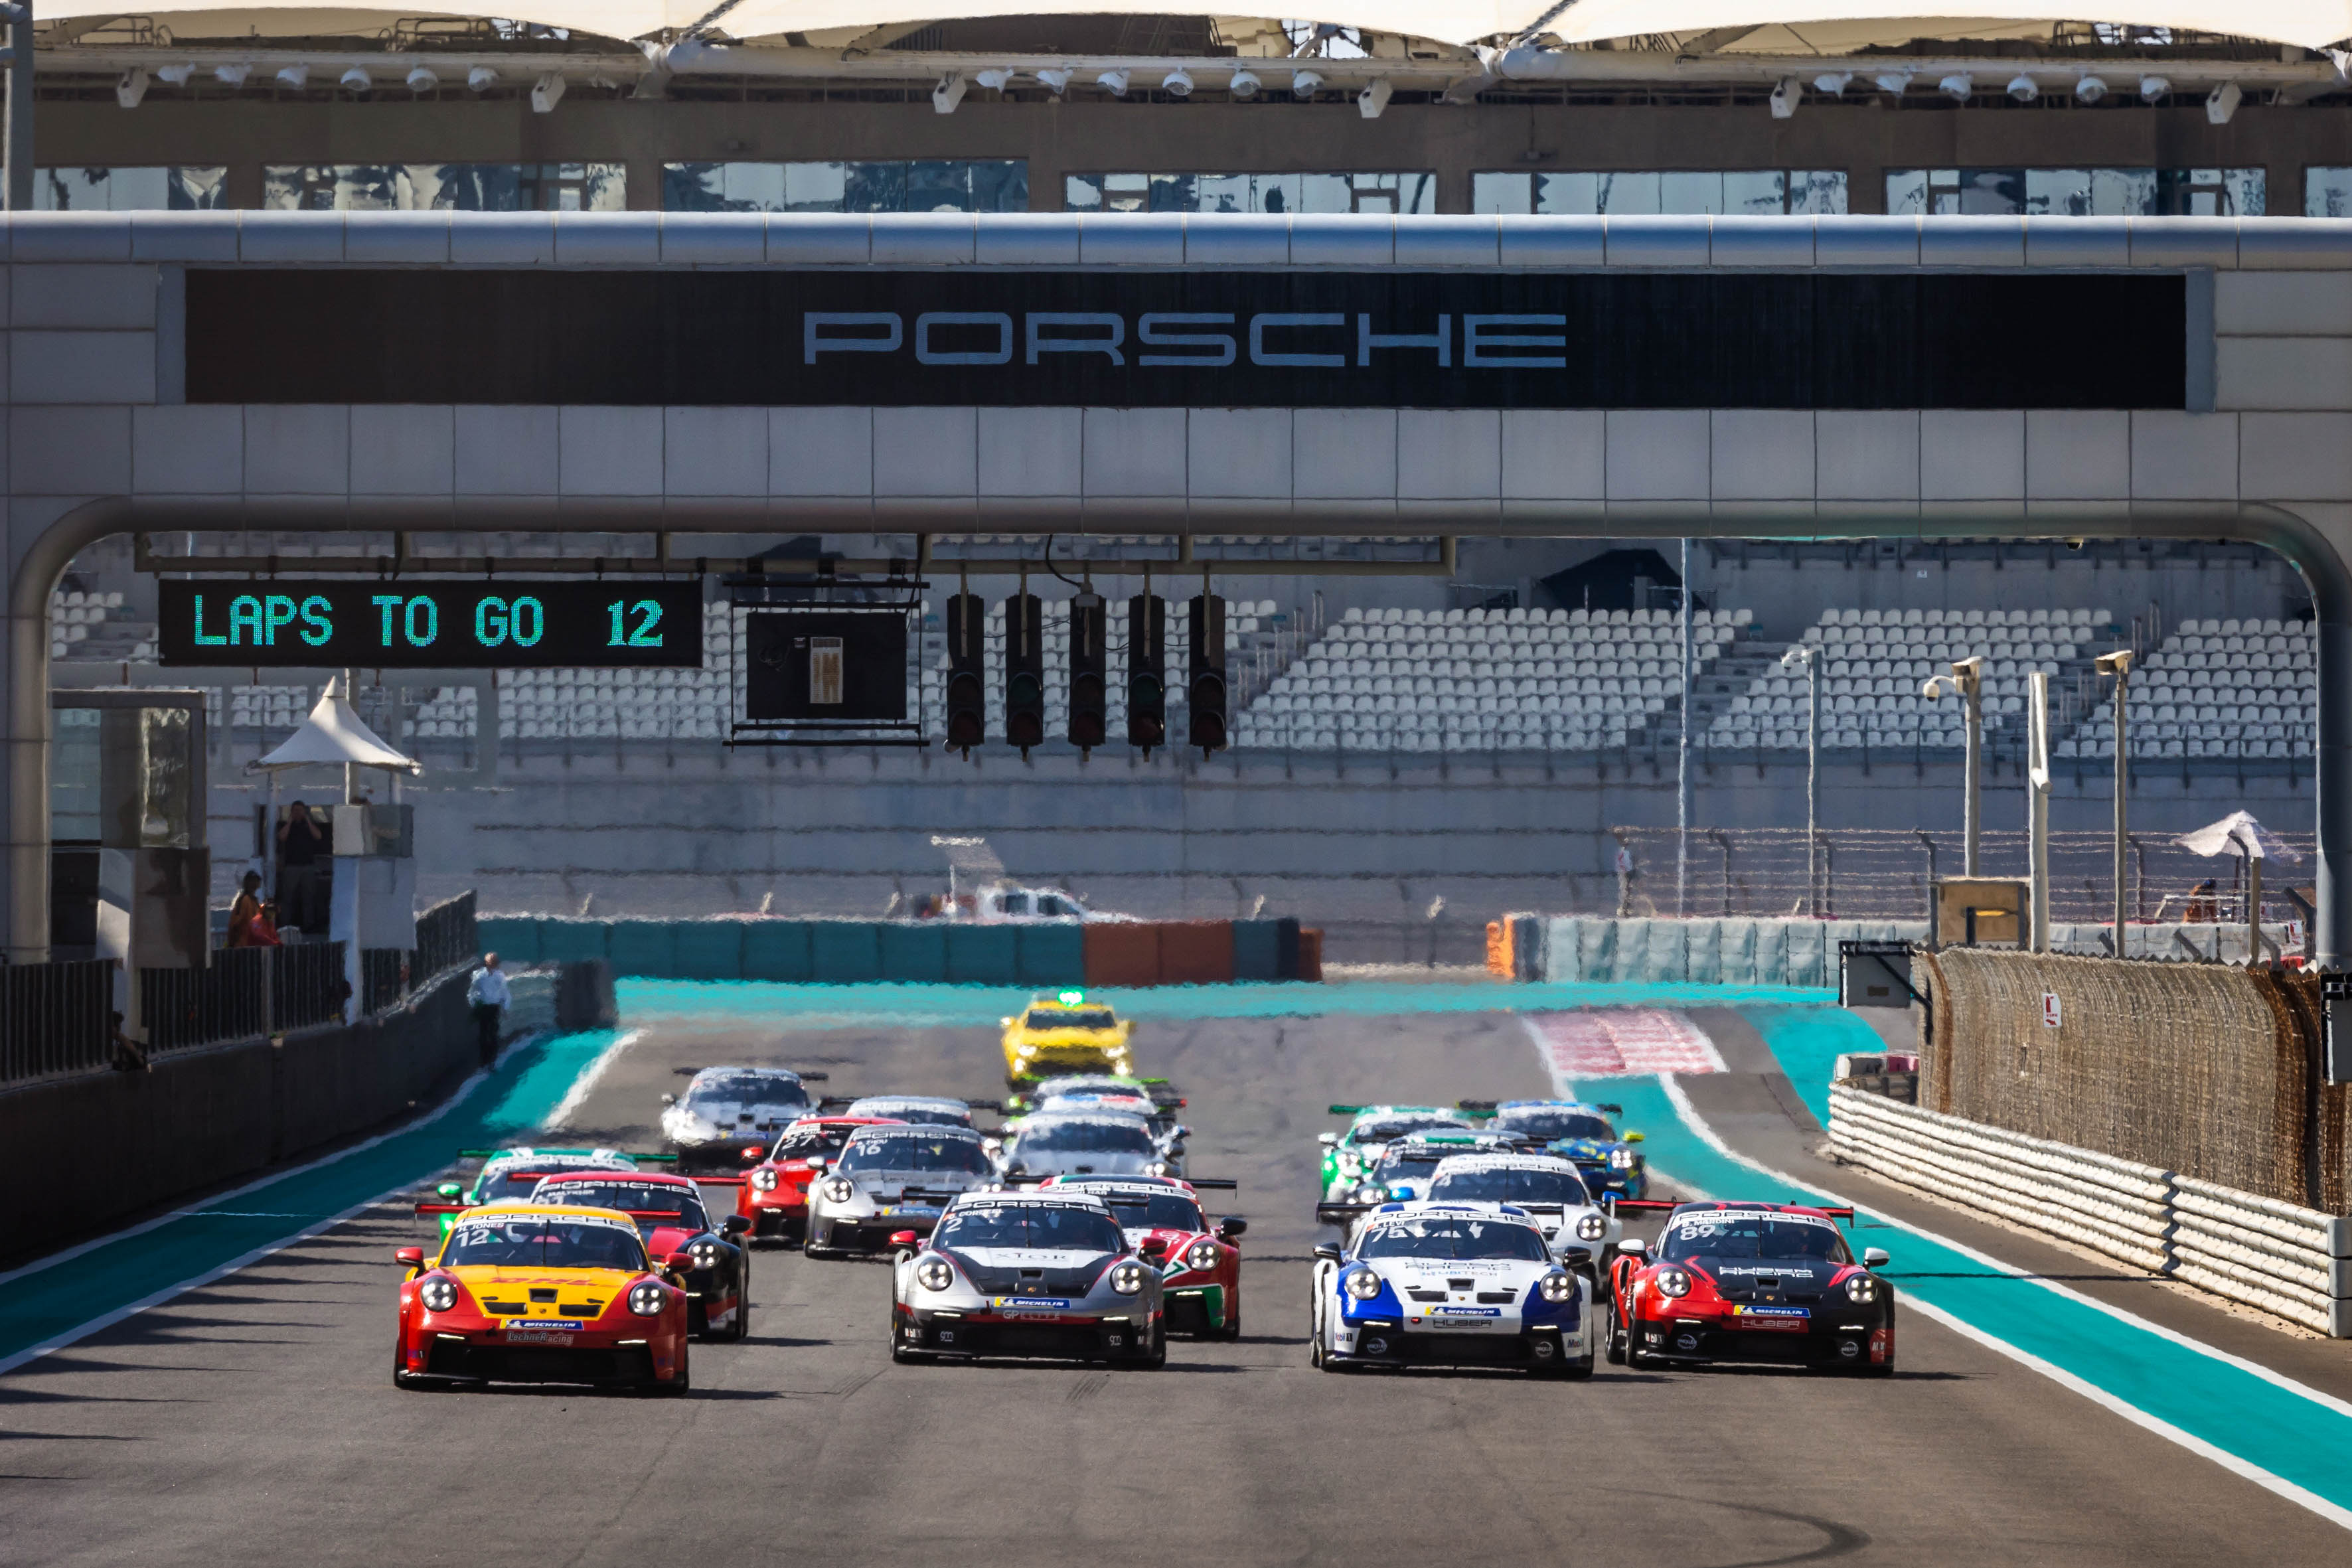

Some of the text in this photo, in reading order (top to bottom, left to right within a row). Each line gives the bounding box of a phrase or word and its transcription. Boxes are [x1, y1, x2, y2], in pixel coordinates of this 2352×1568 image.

[804, 312, 1567, 367] PORSCHE
[195, 595, 663, 647] LAPS TO GO 12
[540, 1180, 693, 1196] PORSCHE
[1042, 1184, 1190, 1198] PORSCHE
[952, 1202, 1110, 1215] PORSCHE
[462, 1214, 634, 1229] PORSCHE
[945, 1217, 963, 1233] 2
[1374, 1212, 1532, 1225] PORSCHE
[1679, 1212, 1832, 1227] PORSCHE
[456, 1229, 491, 1247] 12
[1371, 1227, 1407, 1243] 75
[1680, 1225, 1716, 1241] 89
[1742, 1319, 1800, 1328] HUBER
